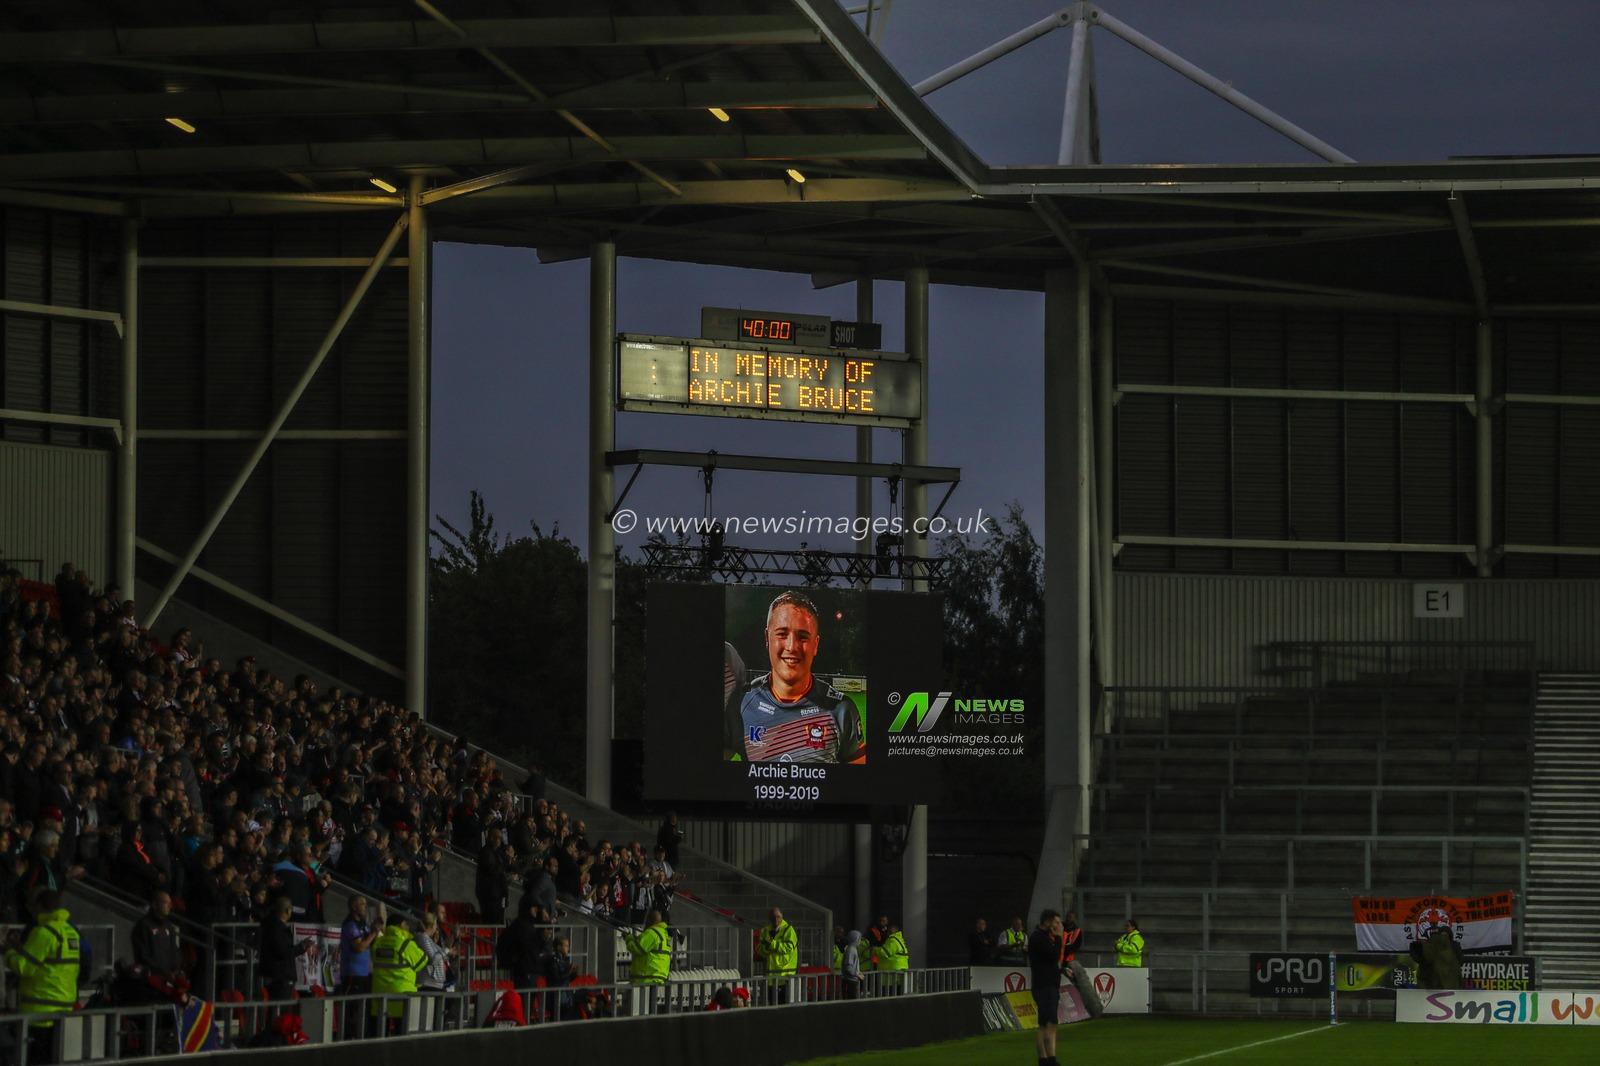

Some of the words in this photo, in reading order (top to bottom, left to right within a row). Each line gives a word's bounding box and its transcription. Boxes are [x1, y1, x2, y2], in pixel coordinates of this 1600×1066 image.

[743, 319, 791, 340] 40:00
[835, 325, 856, 344] SHOT
[691, 350, 719, 373] IN
[735, 353, 828, 380] MEMORY
[845, 361, 874, 383] OF
[689, 378, 781, 405] ARCHIE
[799, 385, 874, 412] BRUCE
[1426, 590, 1449, 611] E1
[748, 764, 788, 778] Archie
[790, 764, 827, 779] Bruce
[754, 785, 820, 800] 1999-2019
[1360, 900, 1380, 909] WIN
[1382, 900, 1395, 910] OR
[1366, 912, 1390, 921] LOSE
[1404, 898, 1447, 940] ASTLEFORD
[1449, 904, 1464, 940] TIGER
[1460, 962, 1530, 980] #HYDRATE
[1426, 991, 1538, 1024] Small
[1551, 997, 1600, 1020] w
